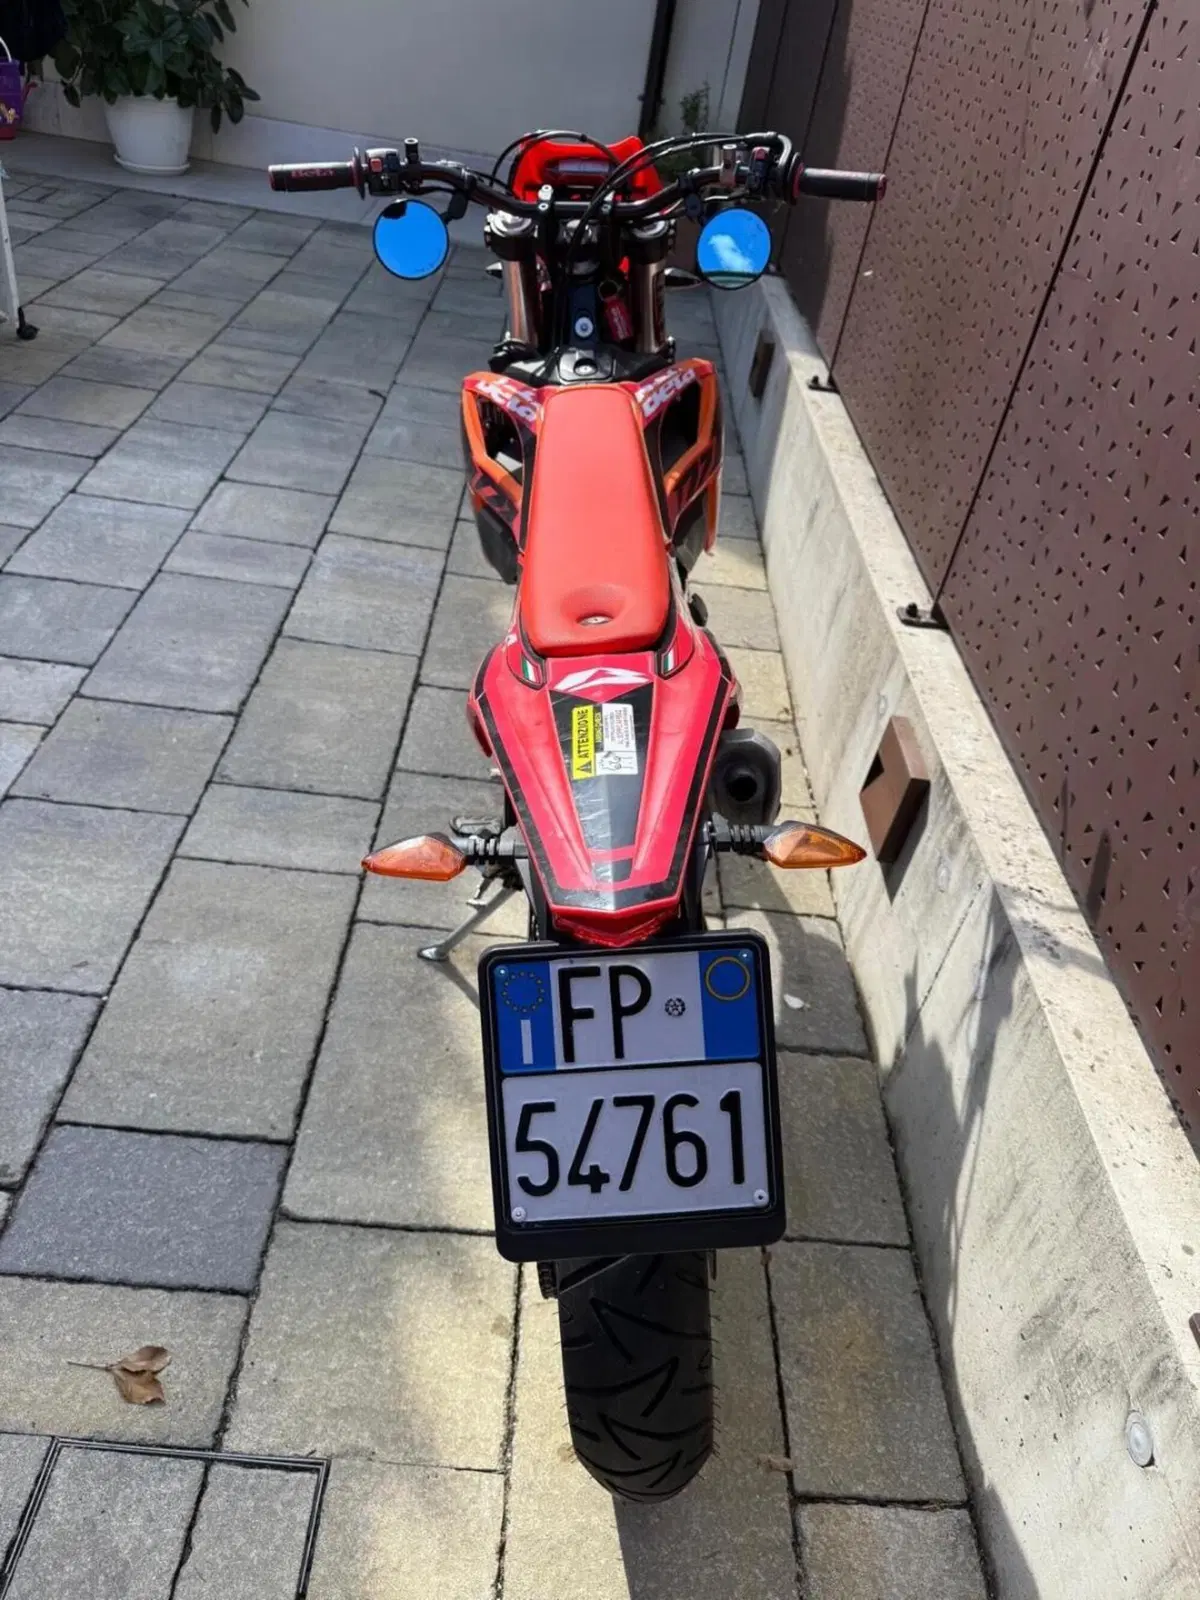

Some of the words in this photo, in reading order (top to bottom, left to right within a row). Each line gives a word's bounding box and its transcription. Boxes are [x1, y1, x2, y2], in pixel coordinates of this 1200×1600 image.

[577, 708, 590, 759] ATTENZIONE
[558, 965, 652, 1063] FP
[515, 1090, 745, 1197] 54761
